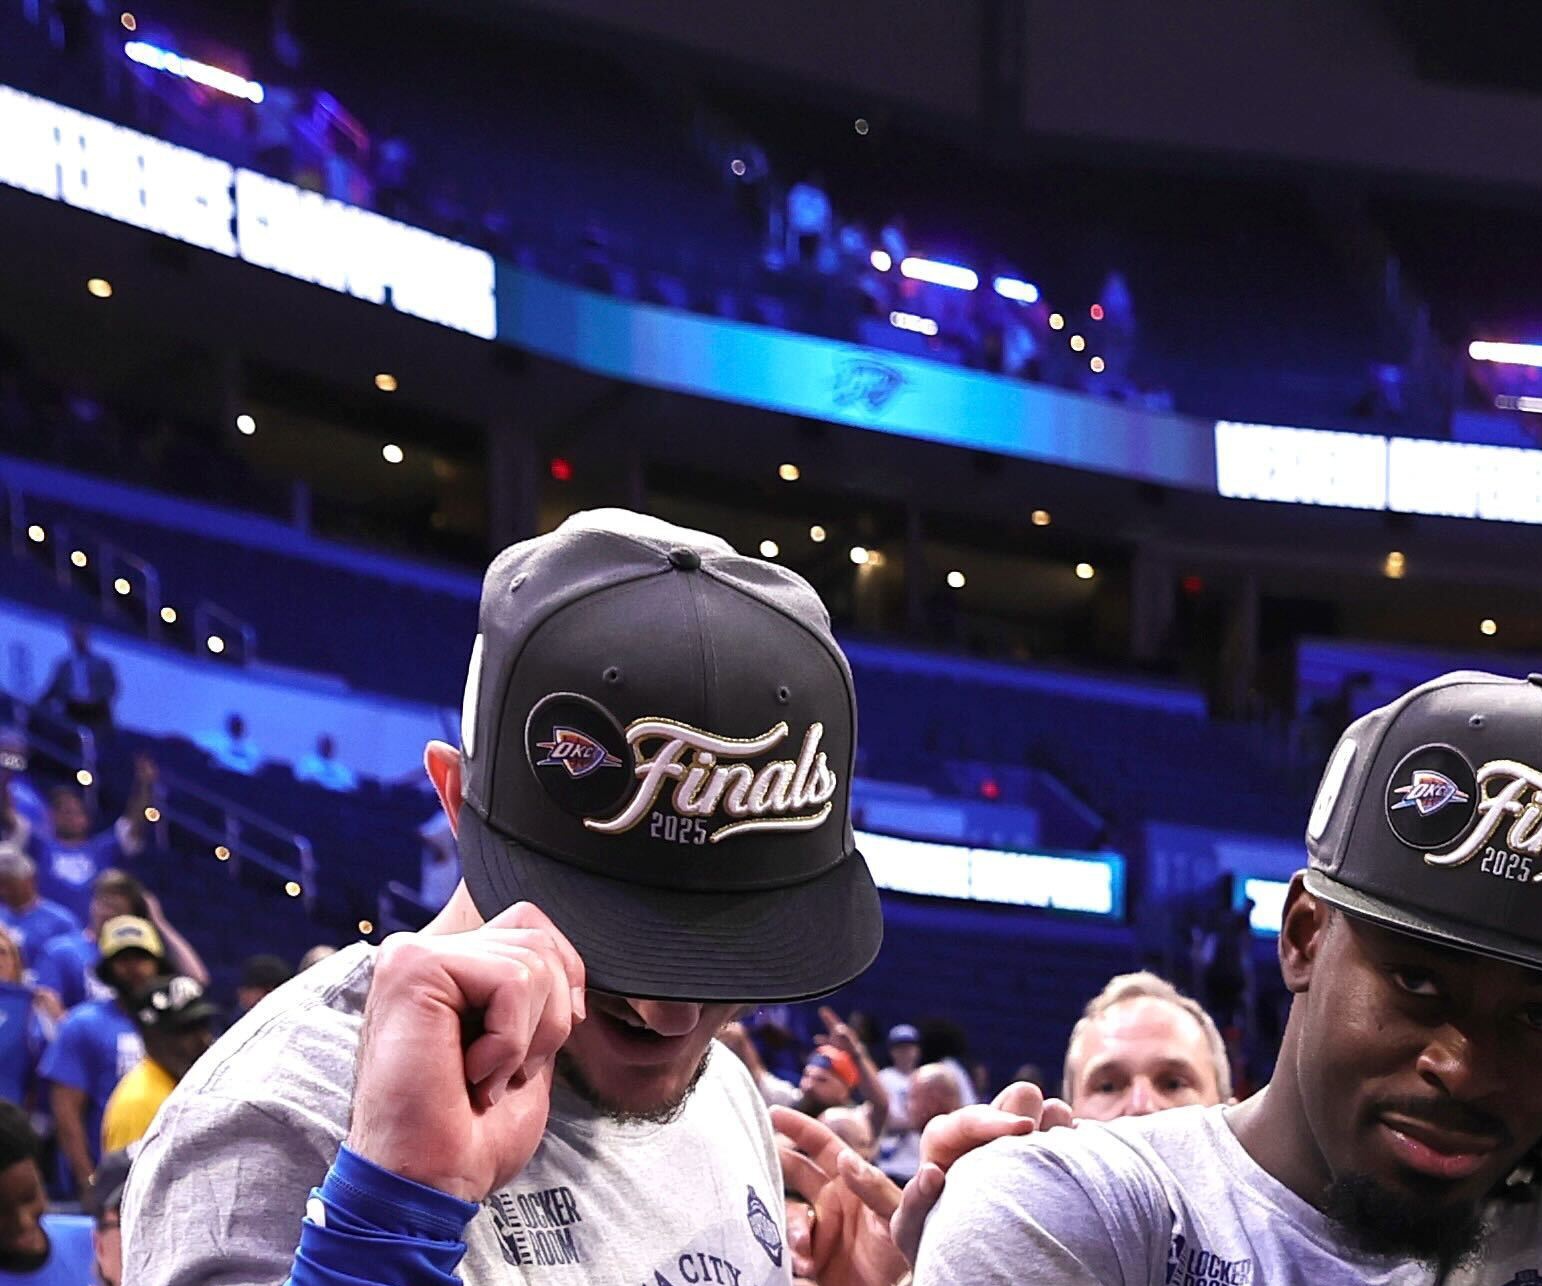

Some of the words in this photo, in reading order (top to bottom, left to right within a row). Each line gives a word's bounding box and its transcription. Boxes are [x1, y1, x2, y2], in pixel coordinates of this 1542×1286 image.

[552, 741, 595, 759] OKC
[583, 716, 837, 842] Finals
[1410, 782, 1453, 799] OKC
[651, 811, 707, 845] 2025
[1481, 847, 1532, 882] 2025
